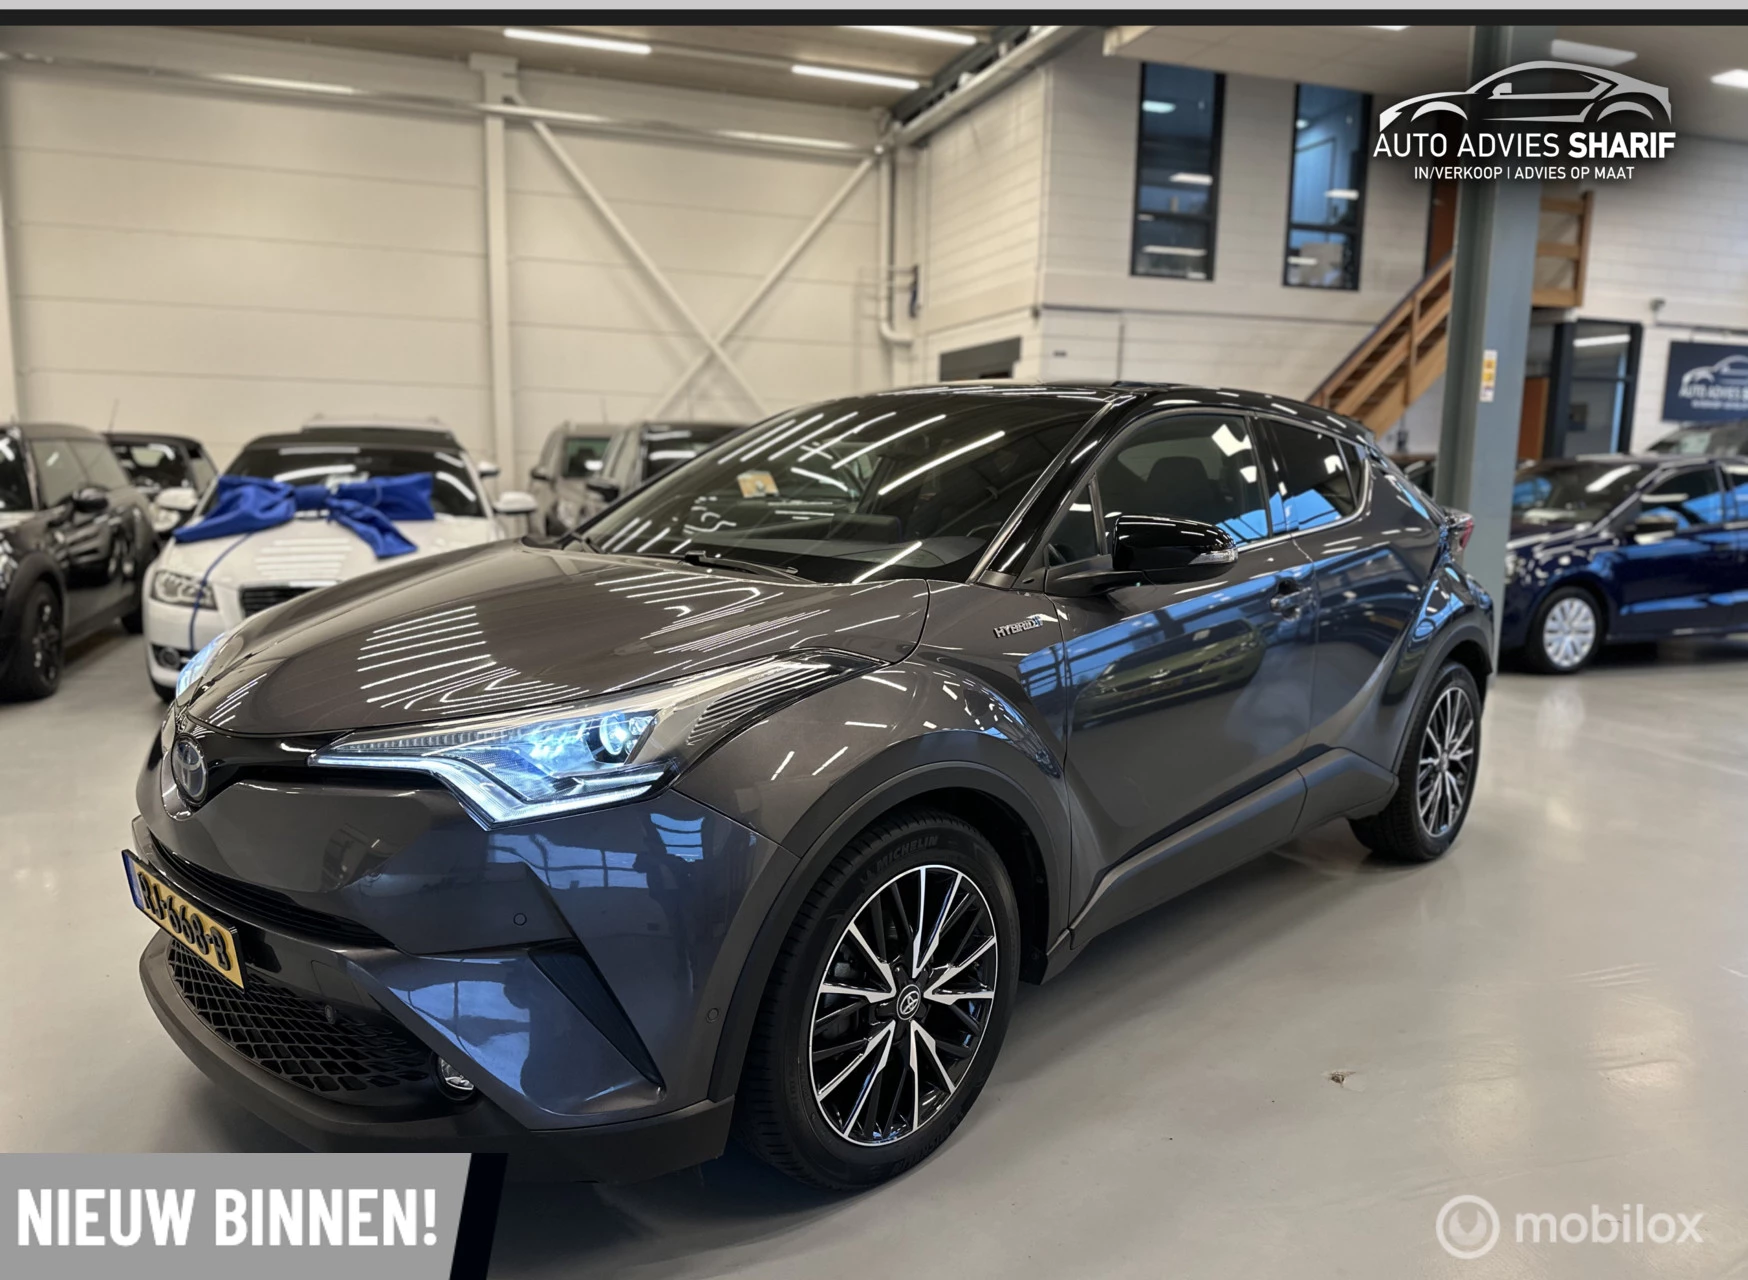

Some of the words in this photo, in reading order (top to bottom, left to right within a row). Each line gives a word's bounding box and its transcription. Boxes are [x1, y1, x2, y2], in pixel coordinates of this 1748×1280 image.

[993, 618, 1038, 638] HYBRID
[877, 835, 939, 871] MICHELIN
[137, 871, 232, 971] RJ-668-B
